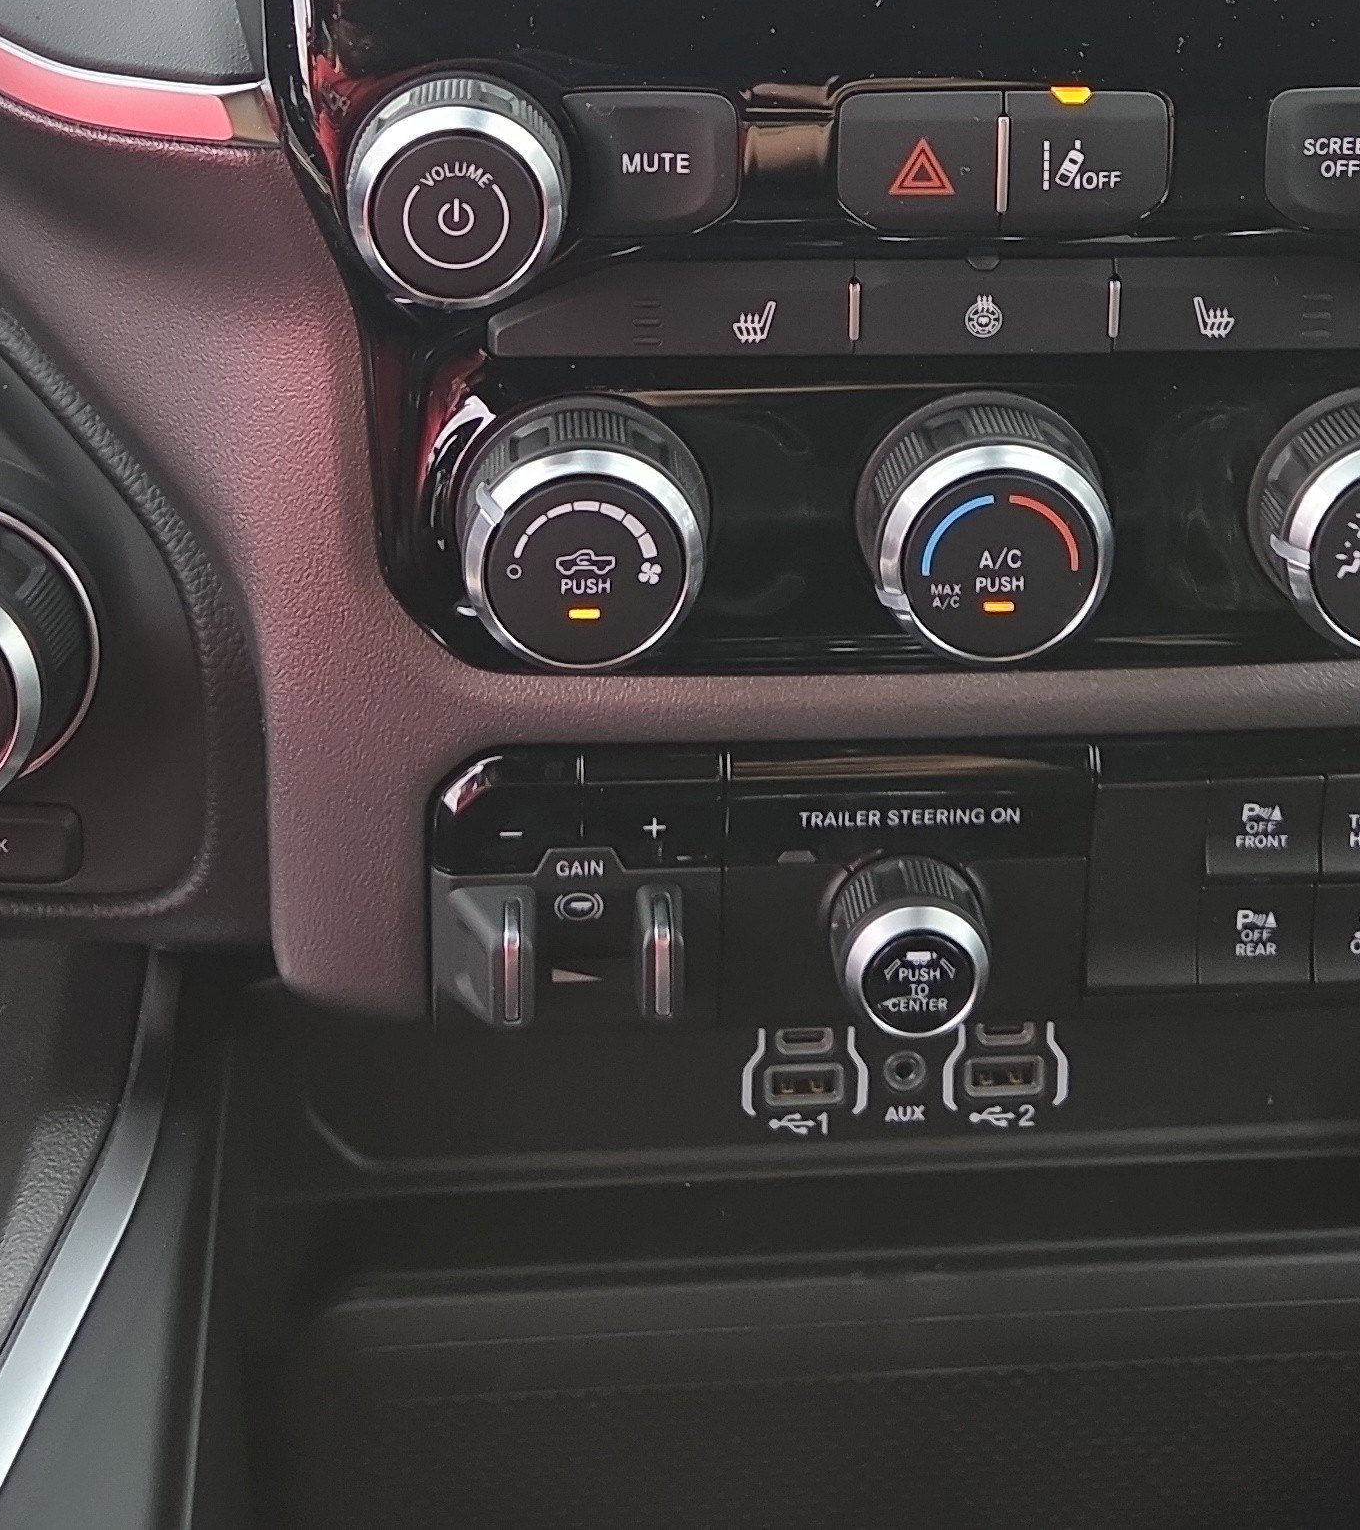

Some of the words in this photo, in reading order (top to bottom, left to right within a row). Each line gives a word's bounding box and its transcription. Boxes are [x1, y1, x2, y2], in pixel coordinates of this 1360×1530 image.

[621, 152, 691, 174] MUTE
[1320, 159, 1360, 179] OFF
[420, 161, 495, 189] VOLUME
[1082, 170, 1121, 191] OFF
[978, 548, 1022, 570] A/C
[560, 578, 611, 596] PUSH
[930, 583, 962, 596] MAX
[975, 574, 1025, 593] PUSH
[931, 595, 960, 609] A/C
[799, 809, 881, 828] TRAILER
[887, 808, 985, 827] STEERING
[990, 806, 1021, 825] ON
[1245, 821, 1277, 834] OFF
[1235, 834, 1288, 848] FRONT
[555, 860, 604, 877] GAIN
[1241, 929, 1272, 942] OFF
[1235, 942, 1277, 957] REAR
[898, 966, 940, 983] PUSH
[910, 982, 929, 998] TO
[889, 996, 948, 1013] CENTER
[884, 1105, 925, 1122] AUX
[1017, 1106, 1036, 1127] 2
[817, 1113, 829, 1135] 1
